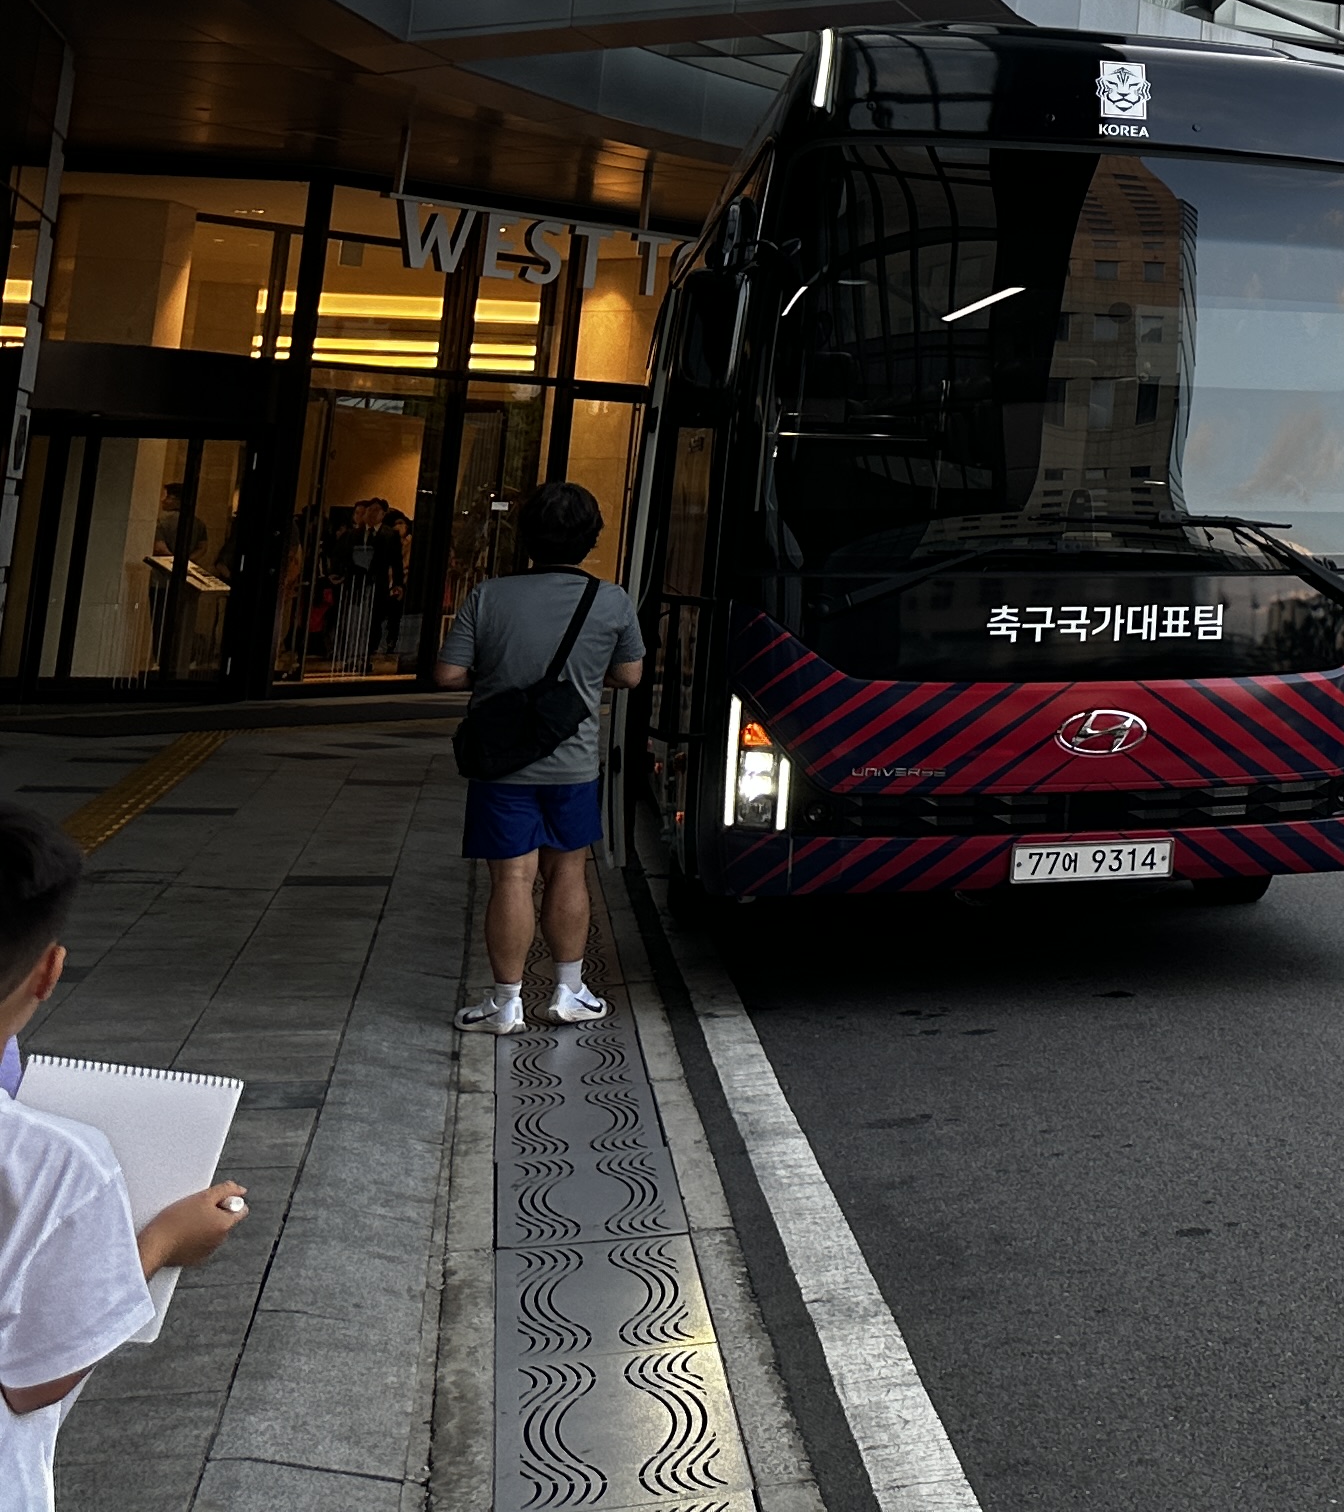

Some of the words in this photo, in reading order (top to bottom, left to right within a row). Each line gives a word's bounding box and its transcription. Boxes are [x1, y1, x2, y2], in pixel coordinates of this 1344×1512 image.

[1098, 123, 1150, 138] KOREA
[402, 199, 614, 289] WEST
[986, 603, 1224, 643] 축구국가대표팀
[1028, 852, 1078, 876] 77어
[1092, 847, 1157, 873] 9314
